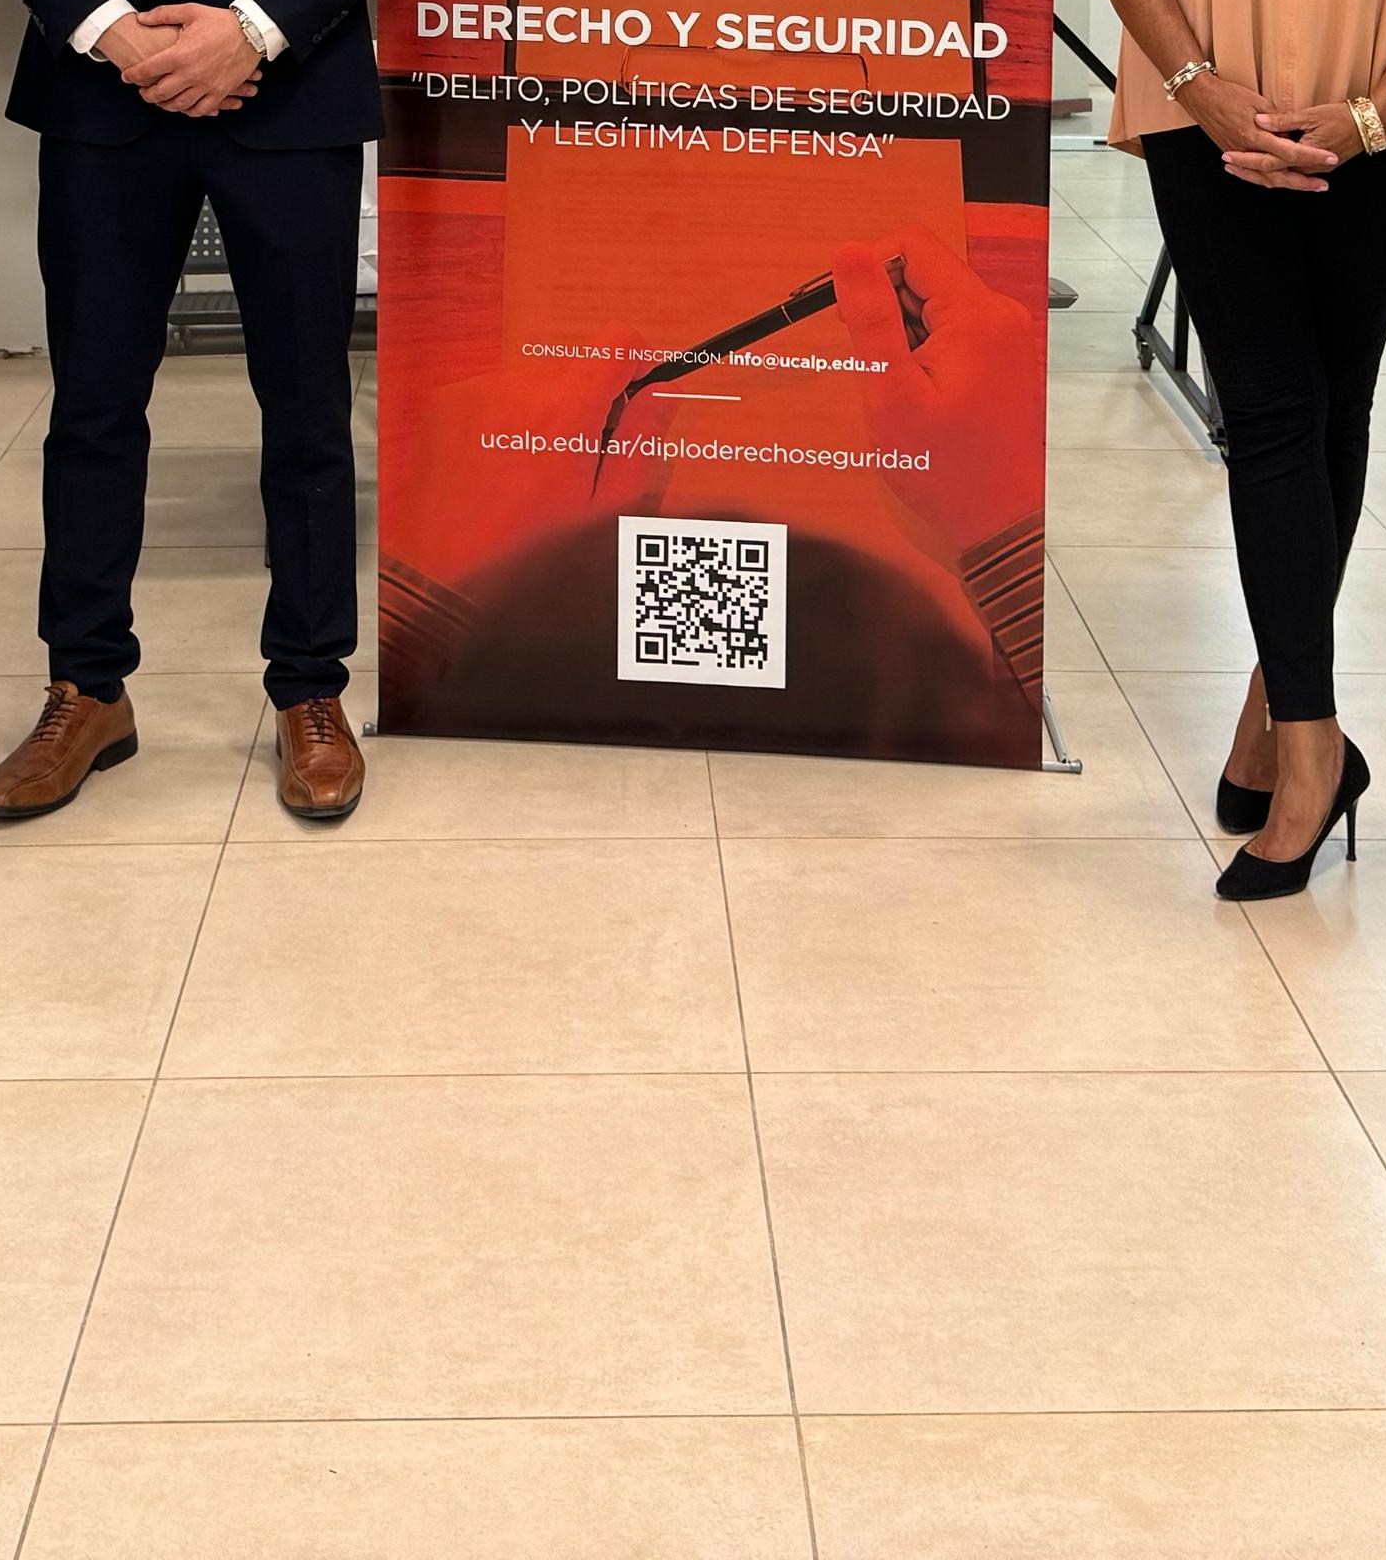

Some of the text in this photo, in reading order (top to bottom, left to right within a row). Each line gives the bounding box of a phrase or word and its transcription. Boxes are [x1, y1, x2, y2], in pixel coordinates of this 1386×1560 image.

[417, 1, 1008, 58] DERECHO Y SEGURIDAD
[412, 72, 1011, 120] "DELITO, POLÍTICAS DE SEGURIDAD
[520, 116, 895, 159] Y LEGÍTIMA DEFENSA"
[522, 343, 611, 360] CONSULTAS
[615, 347, 624, 360] E
[729, 350, 889, 373] info@ucalp.edu.ar
[481, 430, 931, 472] ucalp.edu.ar/diploderechoseguridad
